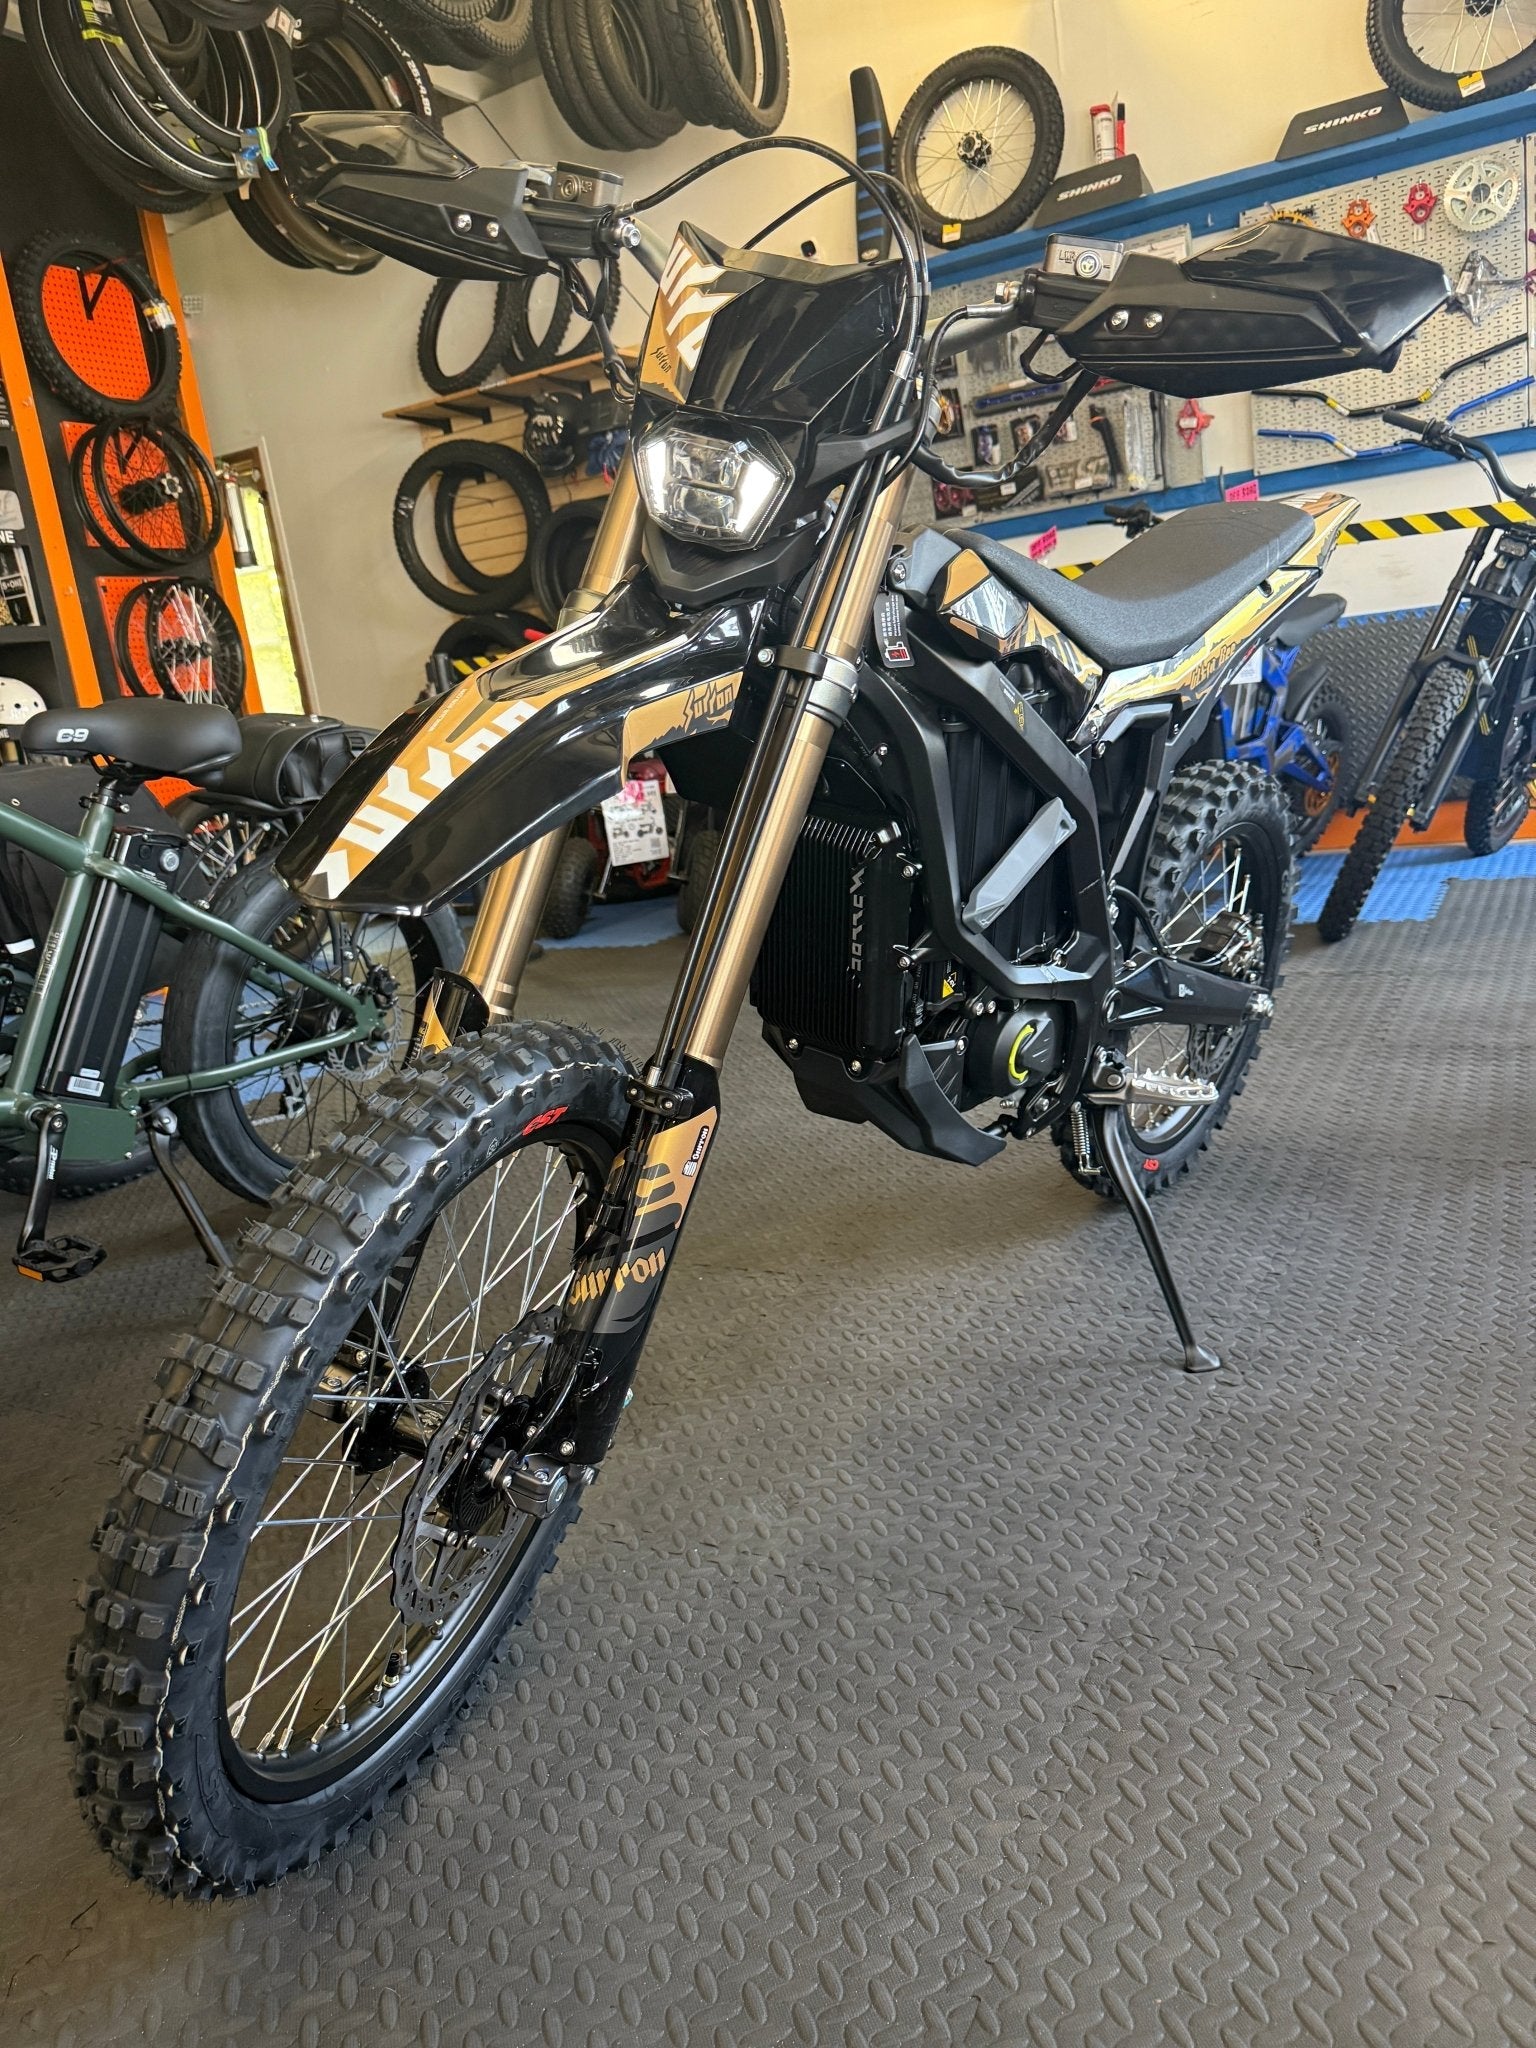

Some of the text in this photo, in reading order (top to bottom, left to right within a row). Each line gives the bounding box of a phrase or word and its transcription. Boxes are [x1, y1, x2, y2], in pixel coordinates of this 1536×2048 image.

[1302, 106, 1363, 135] SHINKO
[1056, 174, 1123, 202] SHINKO
[522, 1105, 569, 1137] CST
